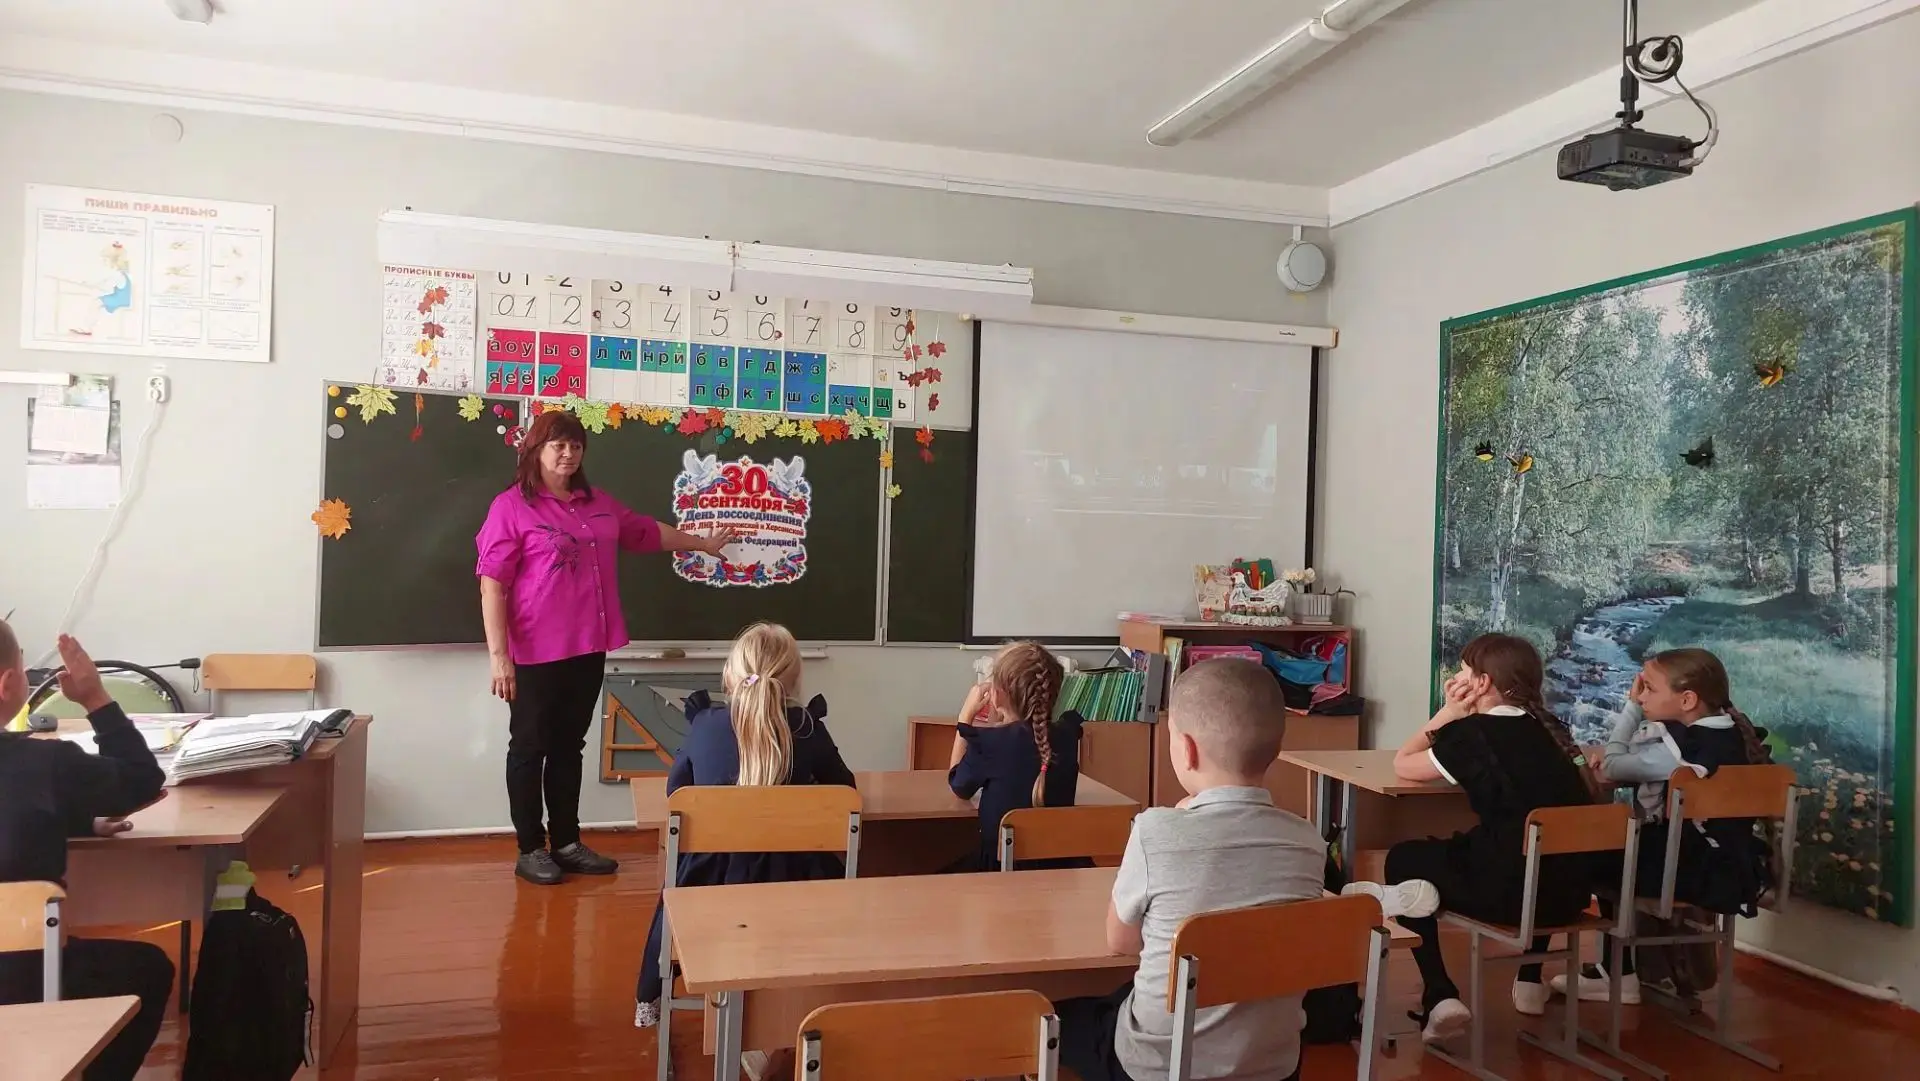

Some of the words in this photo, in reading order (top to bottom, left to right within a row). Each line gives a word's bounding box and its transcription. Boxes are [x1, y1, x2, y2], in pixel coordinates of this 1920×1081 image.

[85, 198, 129, 210] ПИШИ
[133, 202, 218, 218] ПРАВИЛЬНО
[444, 271, 475, 280] БУКВЫ
[498, 294, 515, 316] 0
[525, 296, 537, 318] 1
[562, 295, 581, 325] 2
[613, 300, 631, 329] 3
[663, 303, 681, 333] 4
[711, 308, 729, 337] 5
[758, 312, 775, 340] 6
[806, 316, 821, 344] 7
[848, 320, 865, 348] 8
[892, 324, 908, 351] 9
[721, 464, 768, 496] 30
[698, 493, 783, 512] сентября
[685, 509, 715, 522] День
[717, 510, 803, 528] воссоединения
[744, 536, 797, 547] Федерацией
